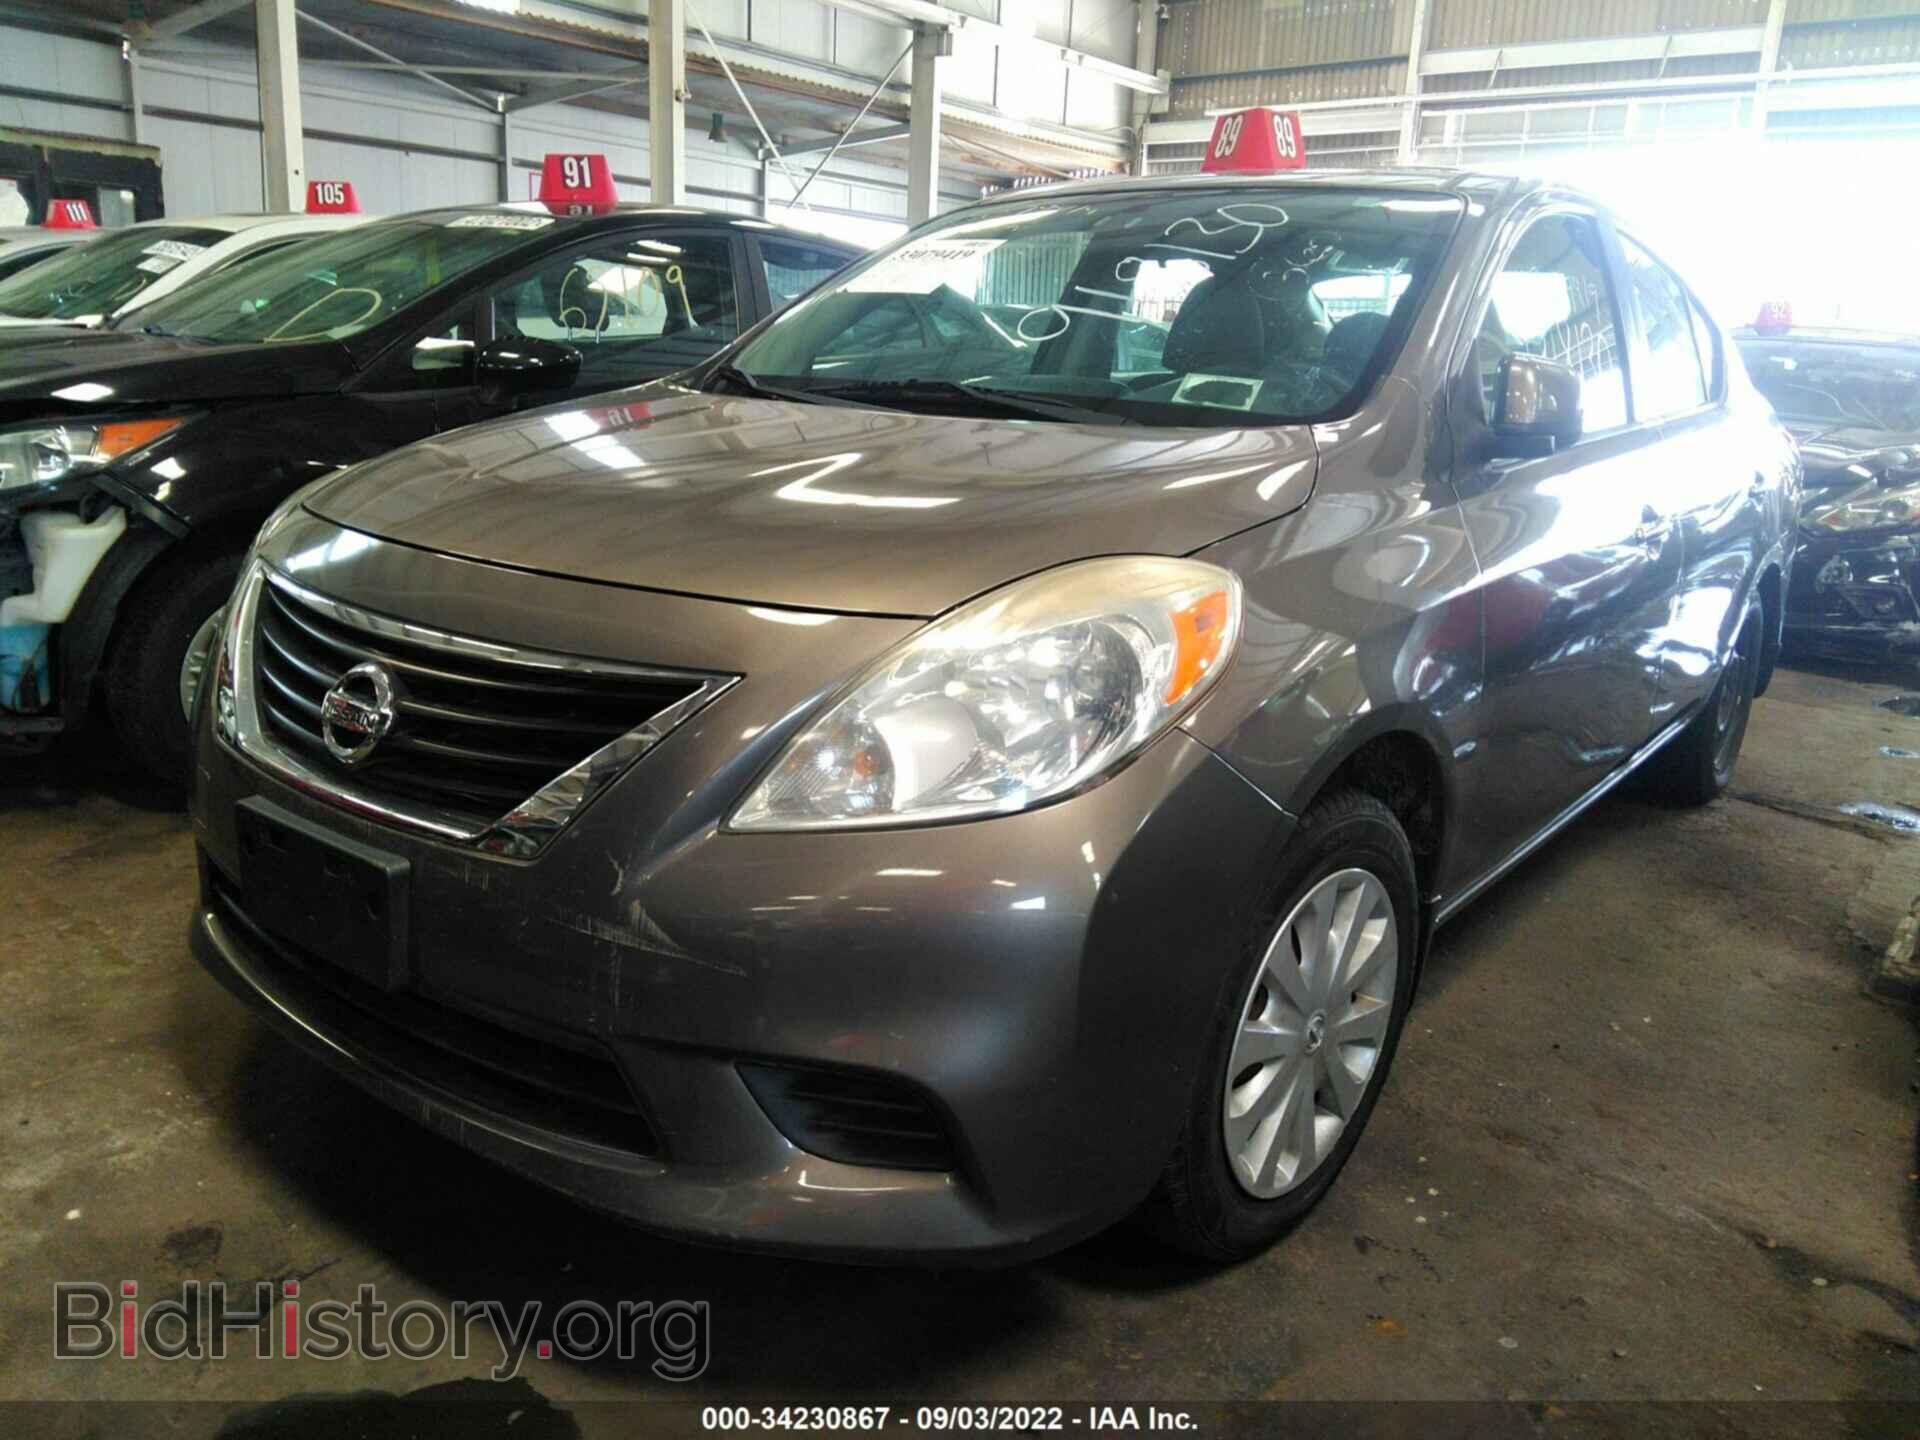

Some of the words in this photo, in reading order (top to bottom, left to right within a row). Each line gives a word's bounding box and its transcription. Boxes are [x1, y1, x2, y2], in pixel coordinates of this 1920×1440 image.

[1214, 114, 1243, 158] 89
[1272, 114, 1297, 158] 89
[563, 156, 592, 189] 91
[315, 183, 345, 205] 105
[66, 202, 88, 222] 111
